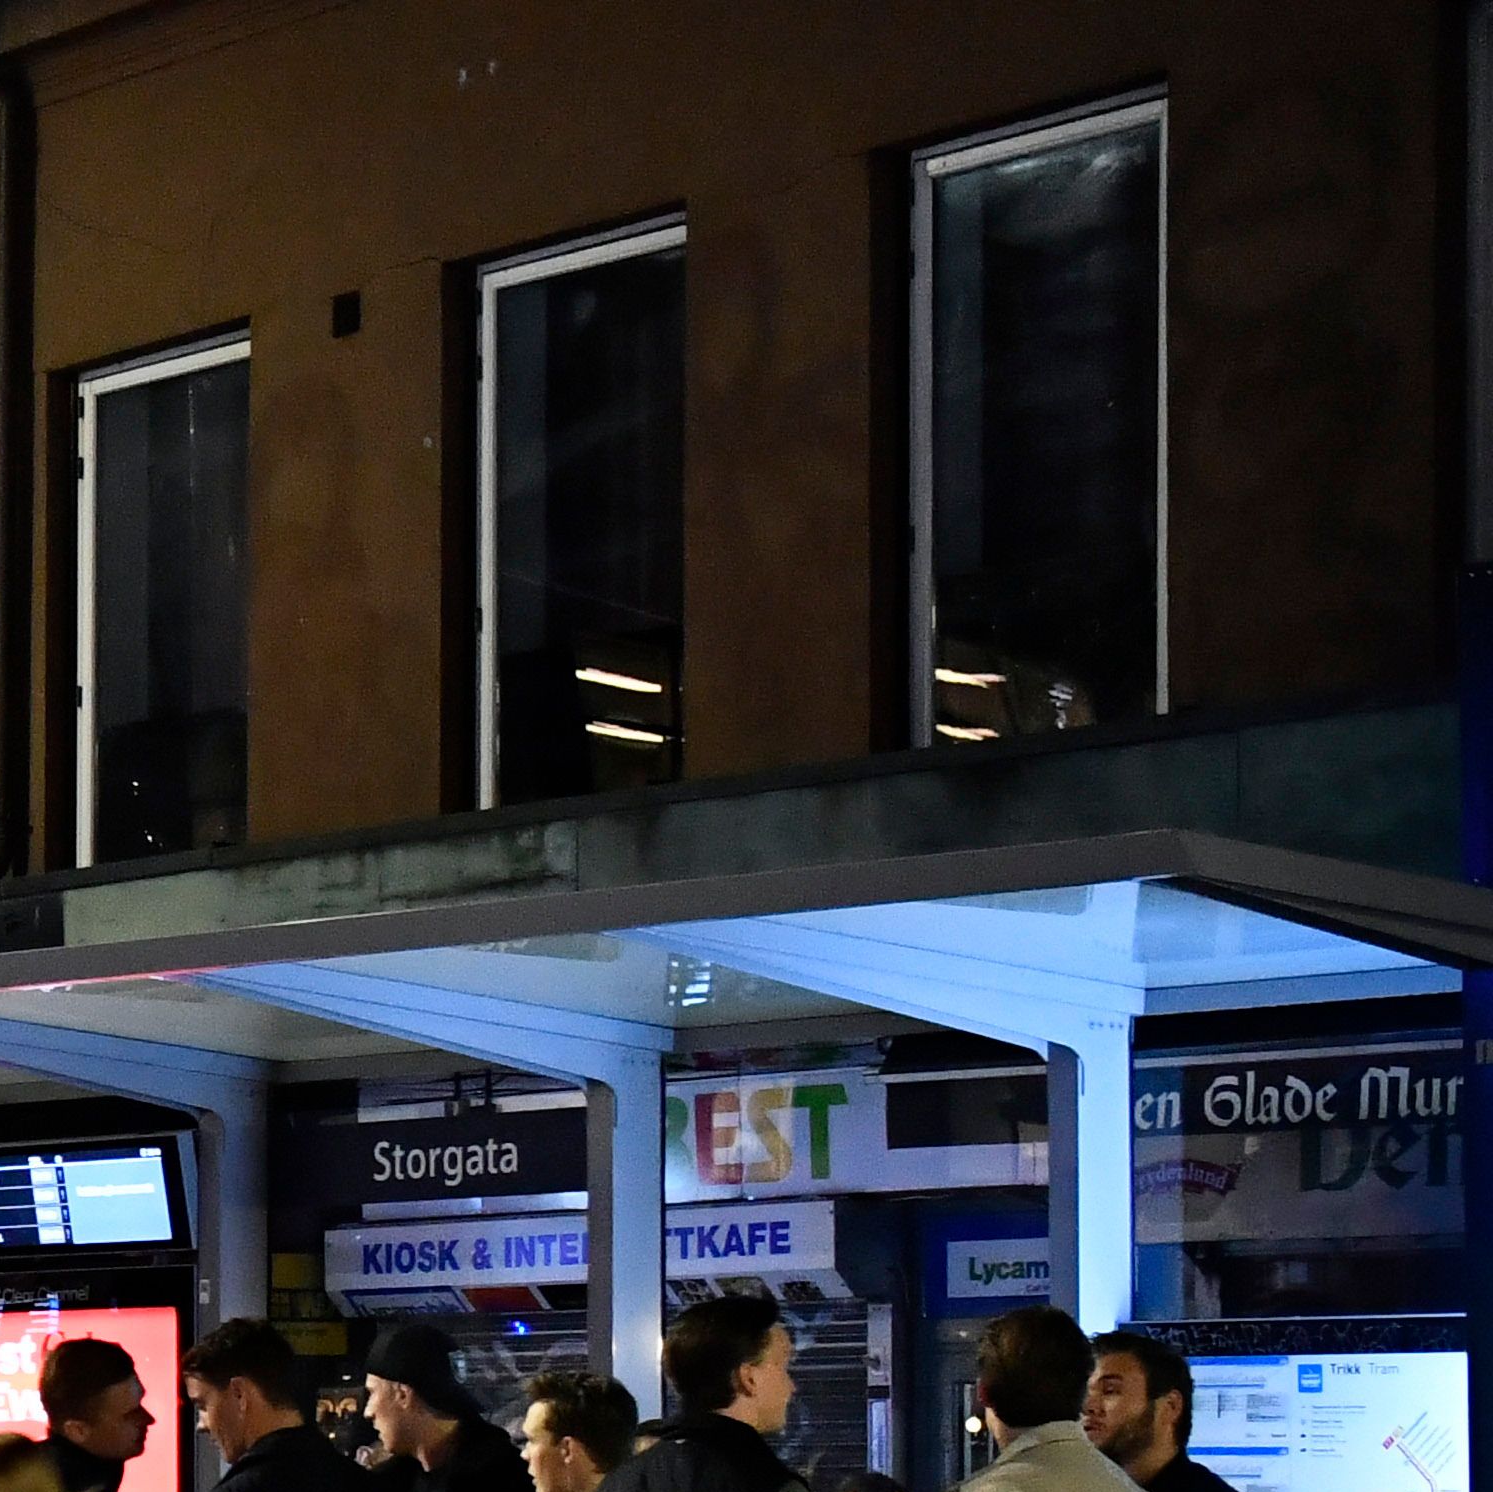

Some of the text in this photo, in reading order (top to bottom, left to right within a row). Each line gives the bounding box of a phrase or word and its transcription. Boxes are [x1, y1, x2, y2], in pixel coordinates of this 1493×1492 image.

[1203, 1070, 1338, 1127] Glade
[373, 1138, 519, 1187] Storgata
[362, 1220, 791, 1275] KIOSK & INTETKAFE
[1330, 1363, 1400, 1375] Trikk Tram
